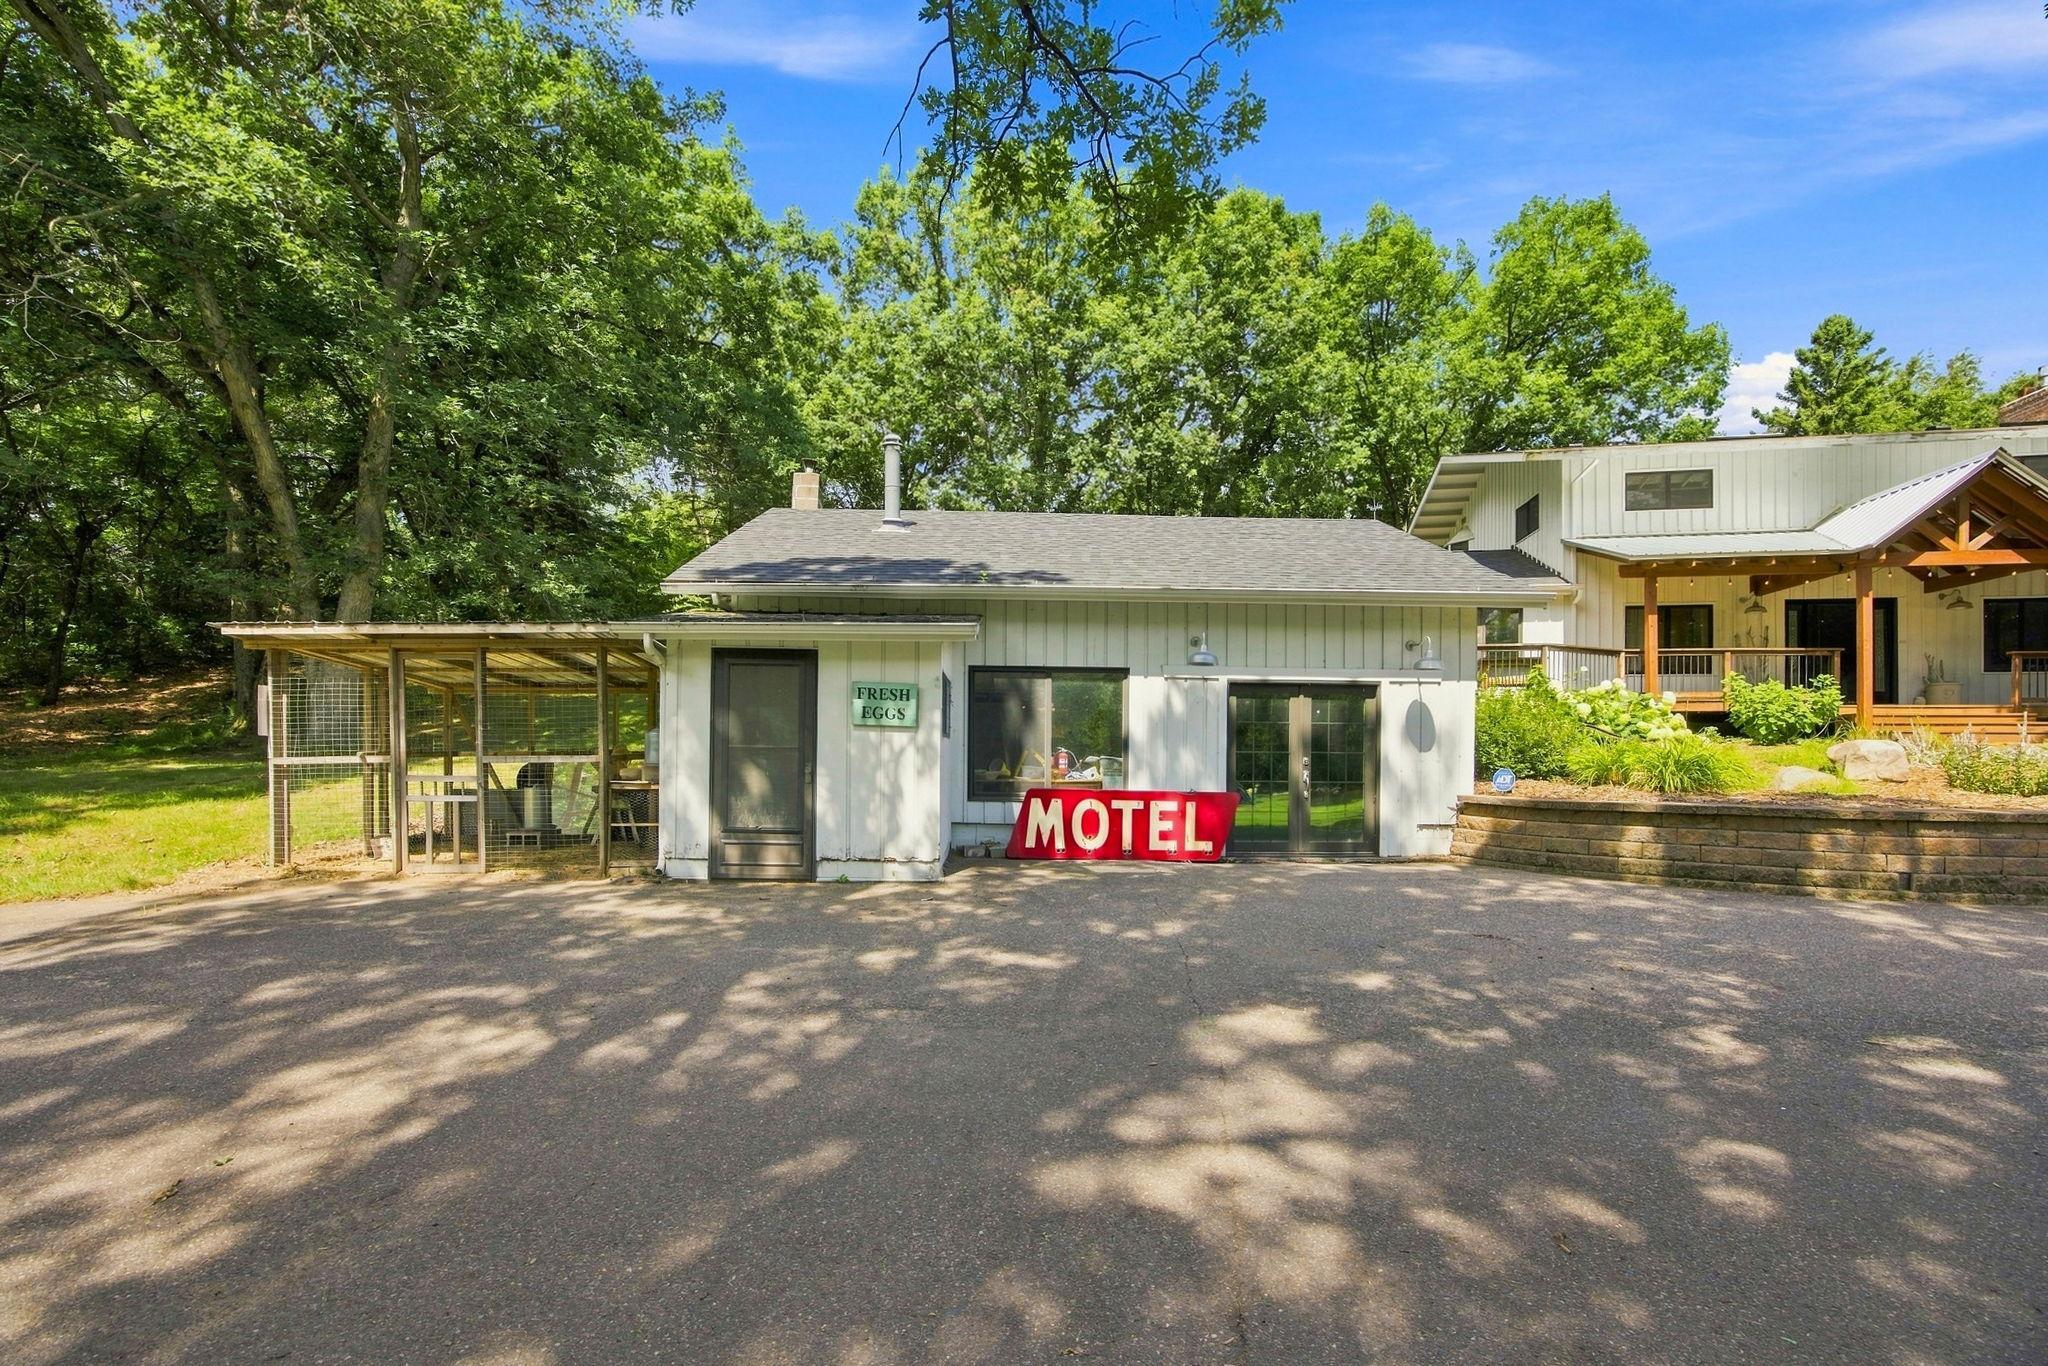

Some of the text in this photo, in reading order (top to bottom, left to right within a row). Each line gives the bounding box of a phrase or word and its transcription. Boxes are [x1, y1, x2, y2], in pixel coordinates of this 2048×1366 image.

[857, 687, 911, 701] FRESH
[861, 706, 906, 720] EGGS
[1497, 775, 1513, 783] ADT
[1025, 798, 1213, 852] MOTEL
